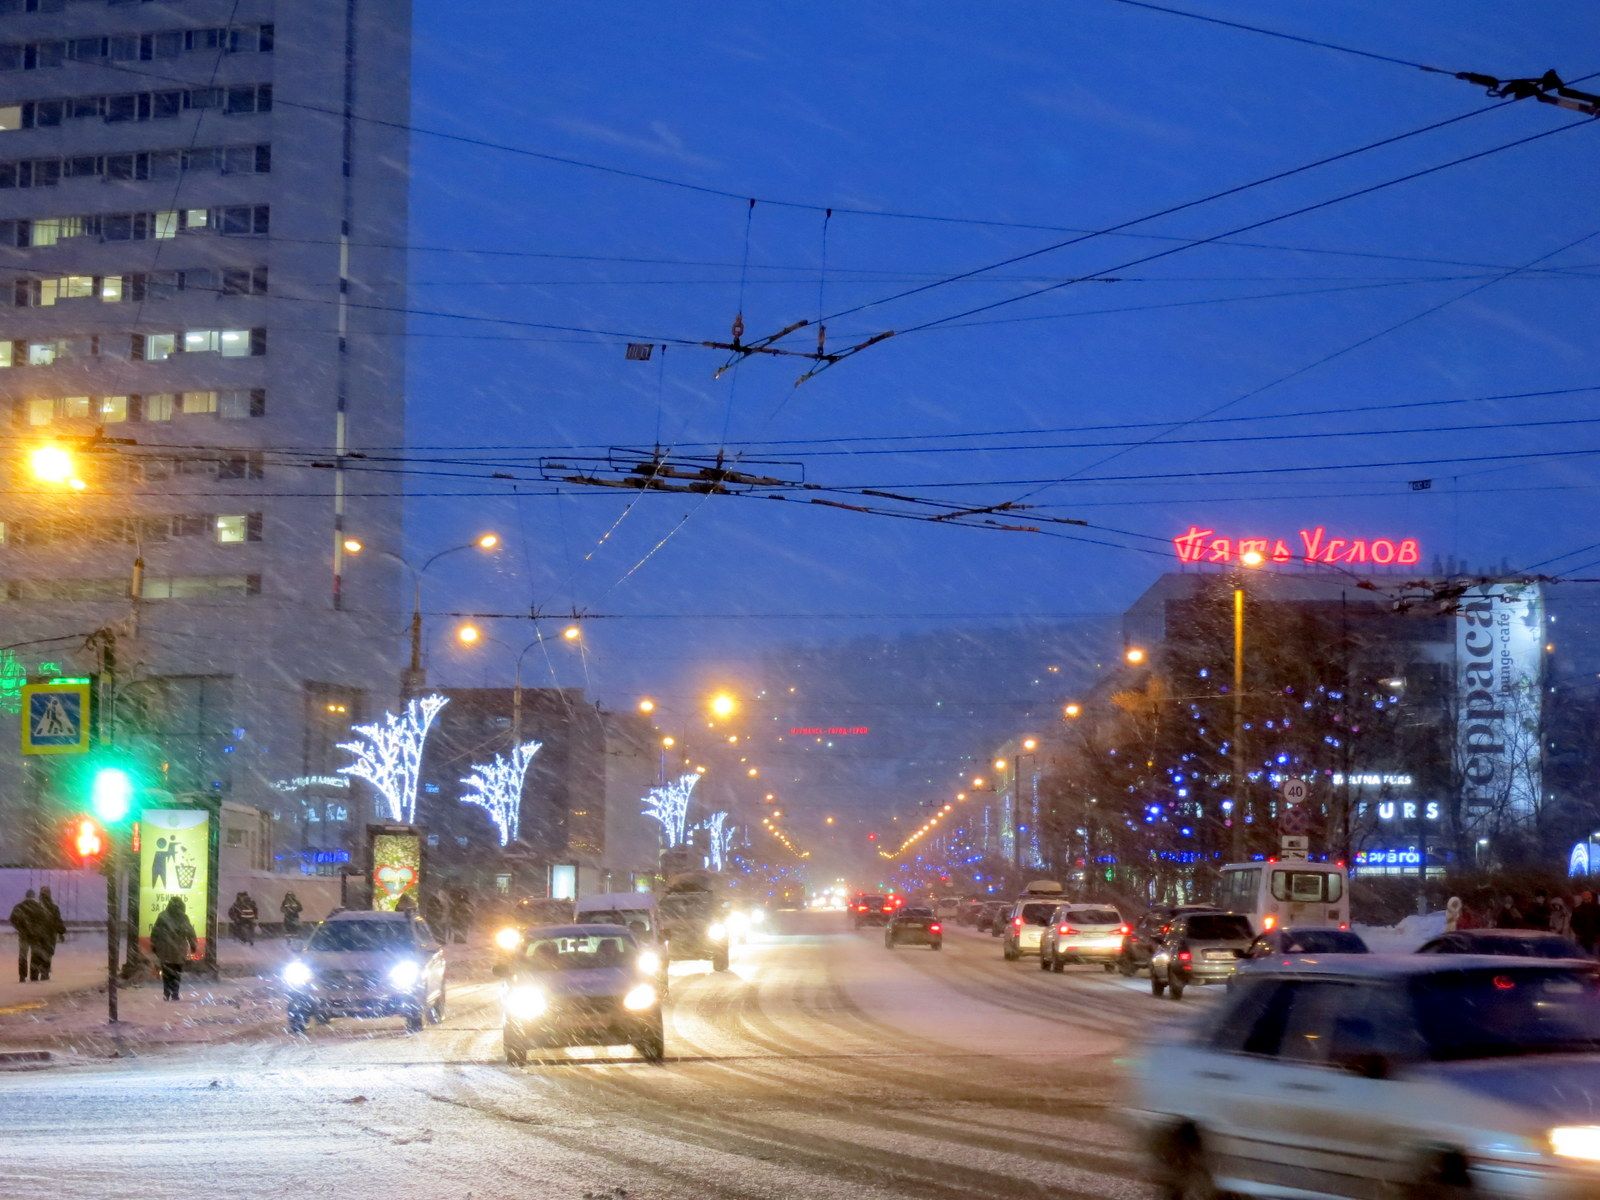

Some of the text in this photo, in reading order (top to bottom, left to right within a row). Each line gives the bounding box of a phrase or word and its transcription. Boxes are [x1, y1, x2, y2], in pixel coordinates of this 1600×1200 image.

[1299, 527, 1419, 564] Углов
[1288, 786, 1303, 797] 40
[1358, 802, 1439, 819] FURS
